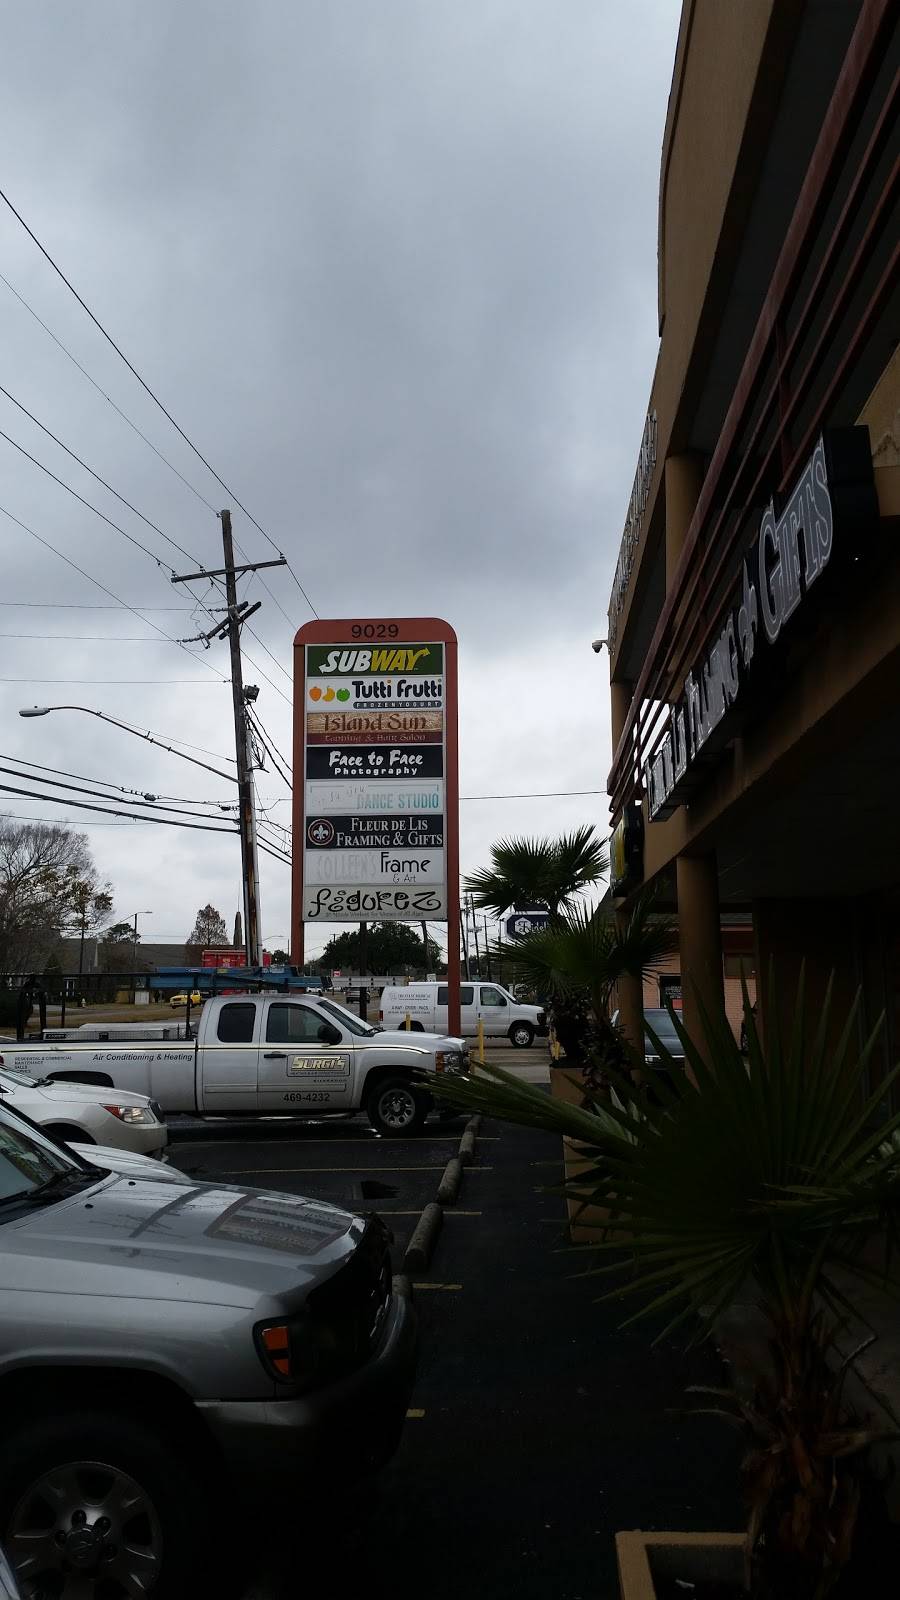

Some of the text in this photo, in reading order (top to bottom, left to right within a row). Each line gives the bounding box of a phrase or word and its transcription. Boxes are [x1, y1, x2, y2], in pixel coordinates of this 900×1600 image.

[351, 623, 400, 639] 9029
[319, 647, 430, 674] SUBWAY
[352, 679, 392, 699] Tutti
[324, 713, 427, 732] Island Sun
[400, 734, 426, 742] Salon
[329, 749, 424, 768] Face to Face
[334, 767, 418, 777] Photography
[357, 794, 393, 810] DANCE
[398, 793, 439, 809] STUDIO
[351, 817, 428, 832] FLEUR DE LIS
[336, 832, 443, 847] FRAMING & GIFTS
[380, 851, 431, 873] Frame
[403, 873, 417, 883] Art
[93, 1053, 193, 1062] Air Conditioning & Heating
[283, 1093, 330, 1102] 469-4232
